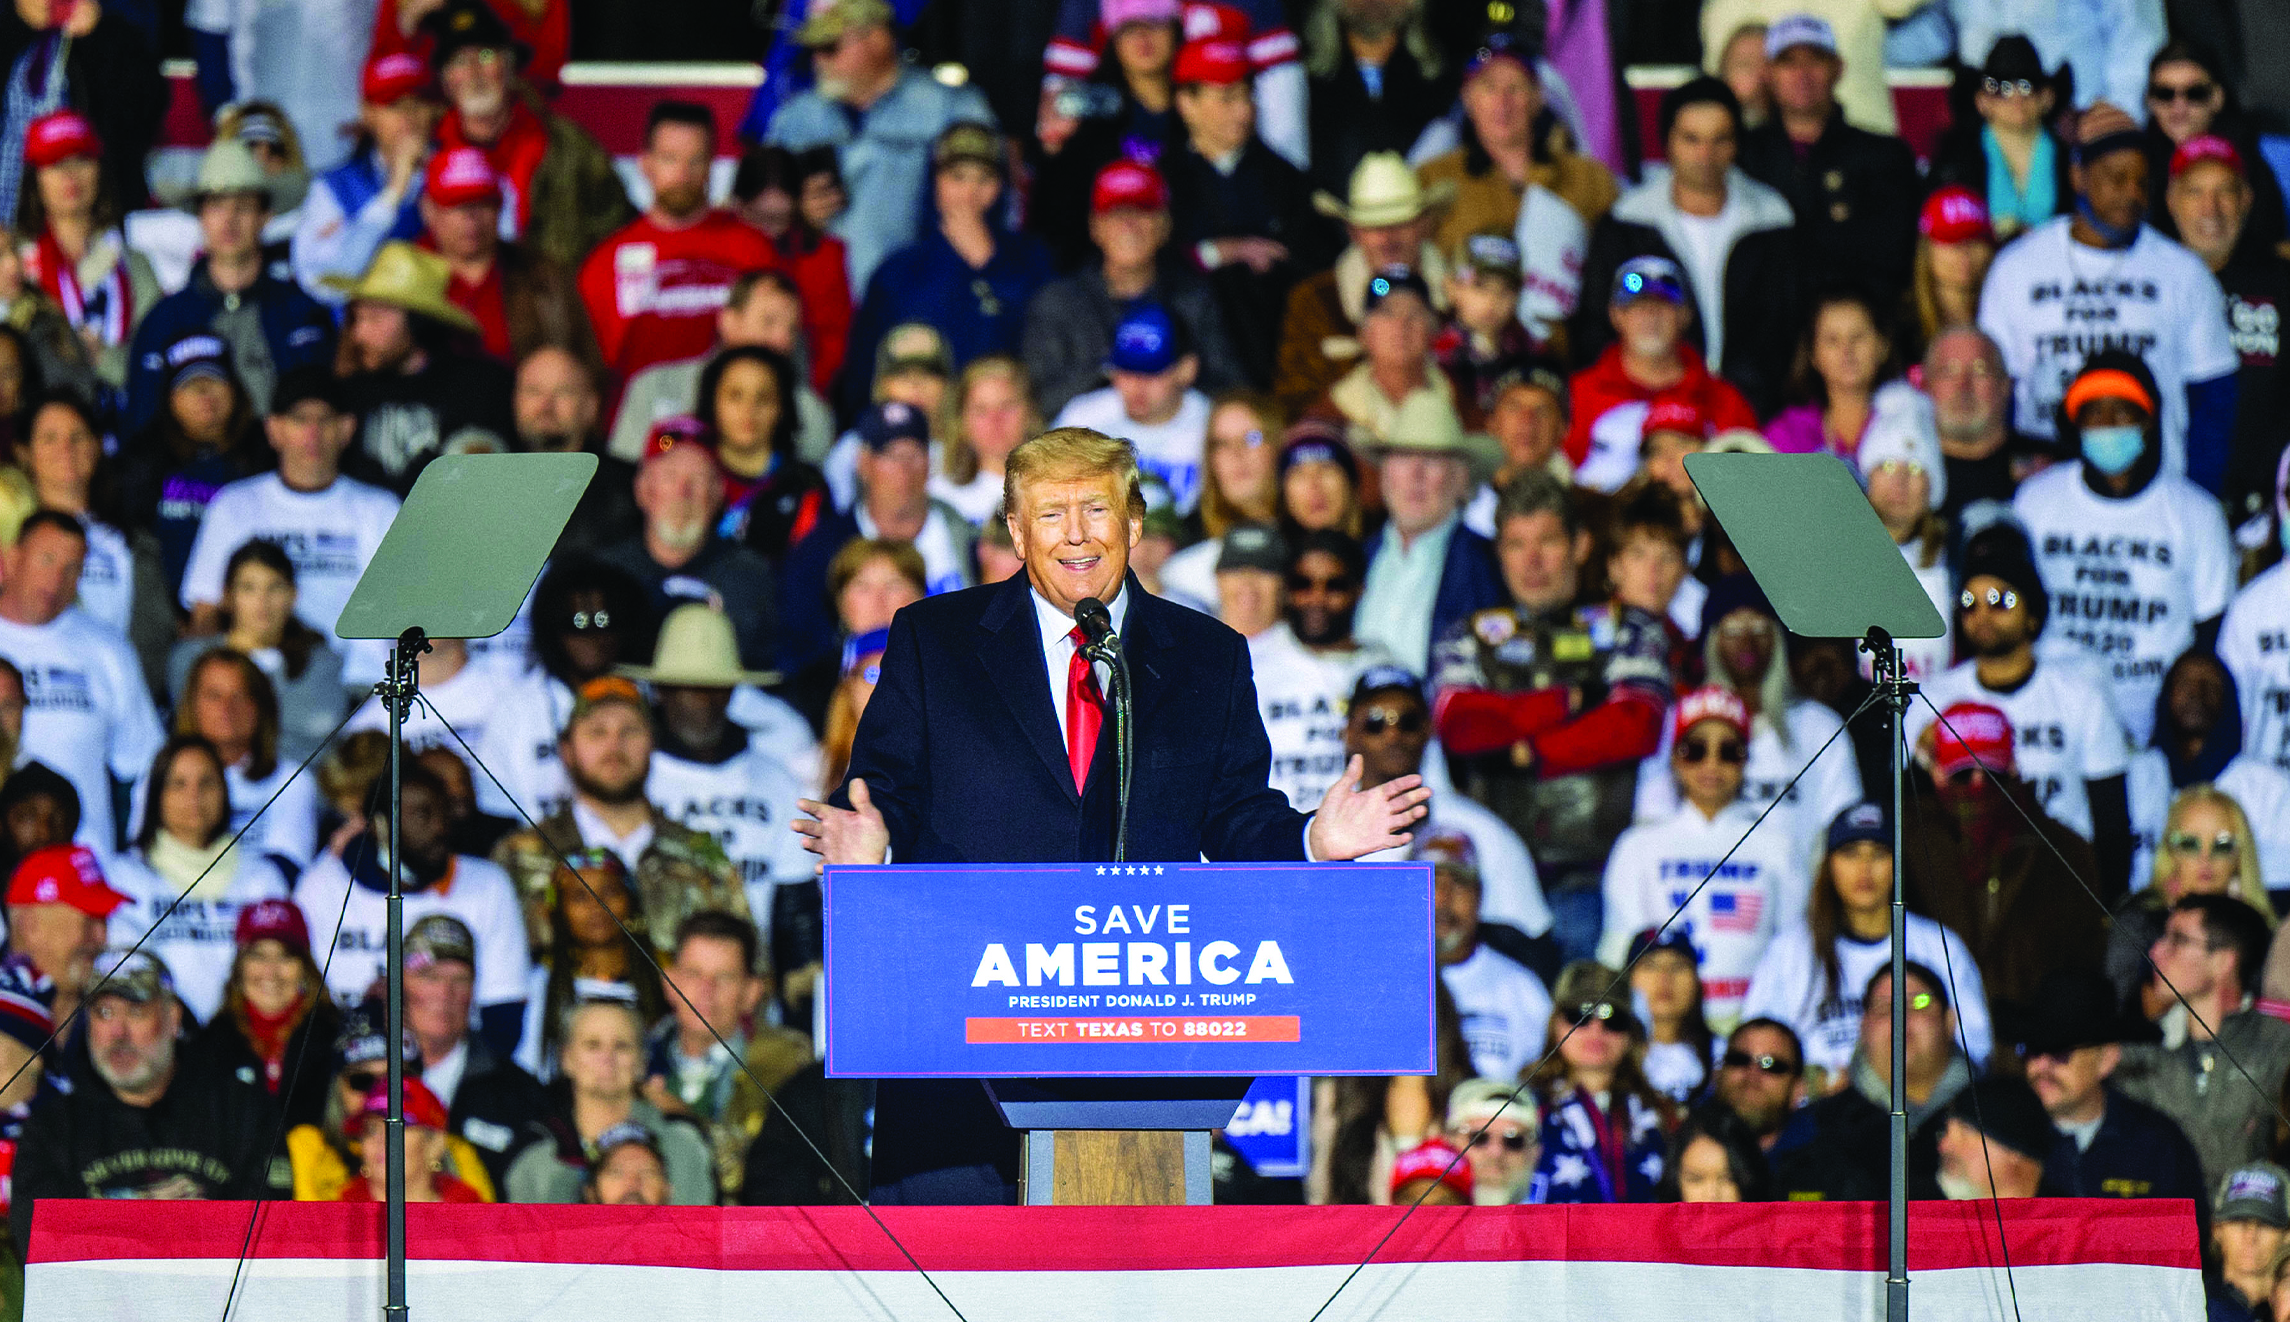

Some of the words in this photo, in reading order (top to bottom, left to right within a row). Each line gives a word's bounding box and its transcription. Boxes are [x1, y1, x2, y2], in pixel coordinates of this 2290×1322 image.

[2042, 534, 2172, 567] BLACKS
[1074, 904, 1191, 935] SAVE
[970, 940, 1295, 988] AMERICA
[1009, 994, 1100, 1008] PRESIDENT
[1106, 994, 1176, 1008] DONALD
[1182, 994, 1195, 1007] J.
[1200, 993, 1257, 1007] TRUMP
[1017, 1021, 1070, 1038] TEXT
[1076, 1021, 1144, 1038] TEXAS
[1153, 1021, 1177, 1038] TO
[1183, 1021, 1248, 1038] 88022
